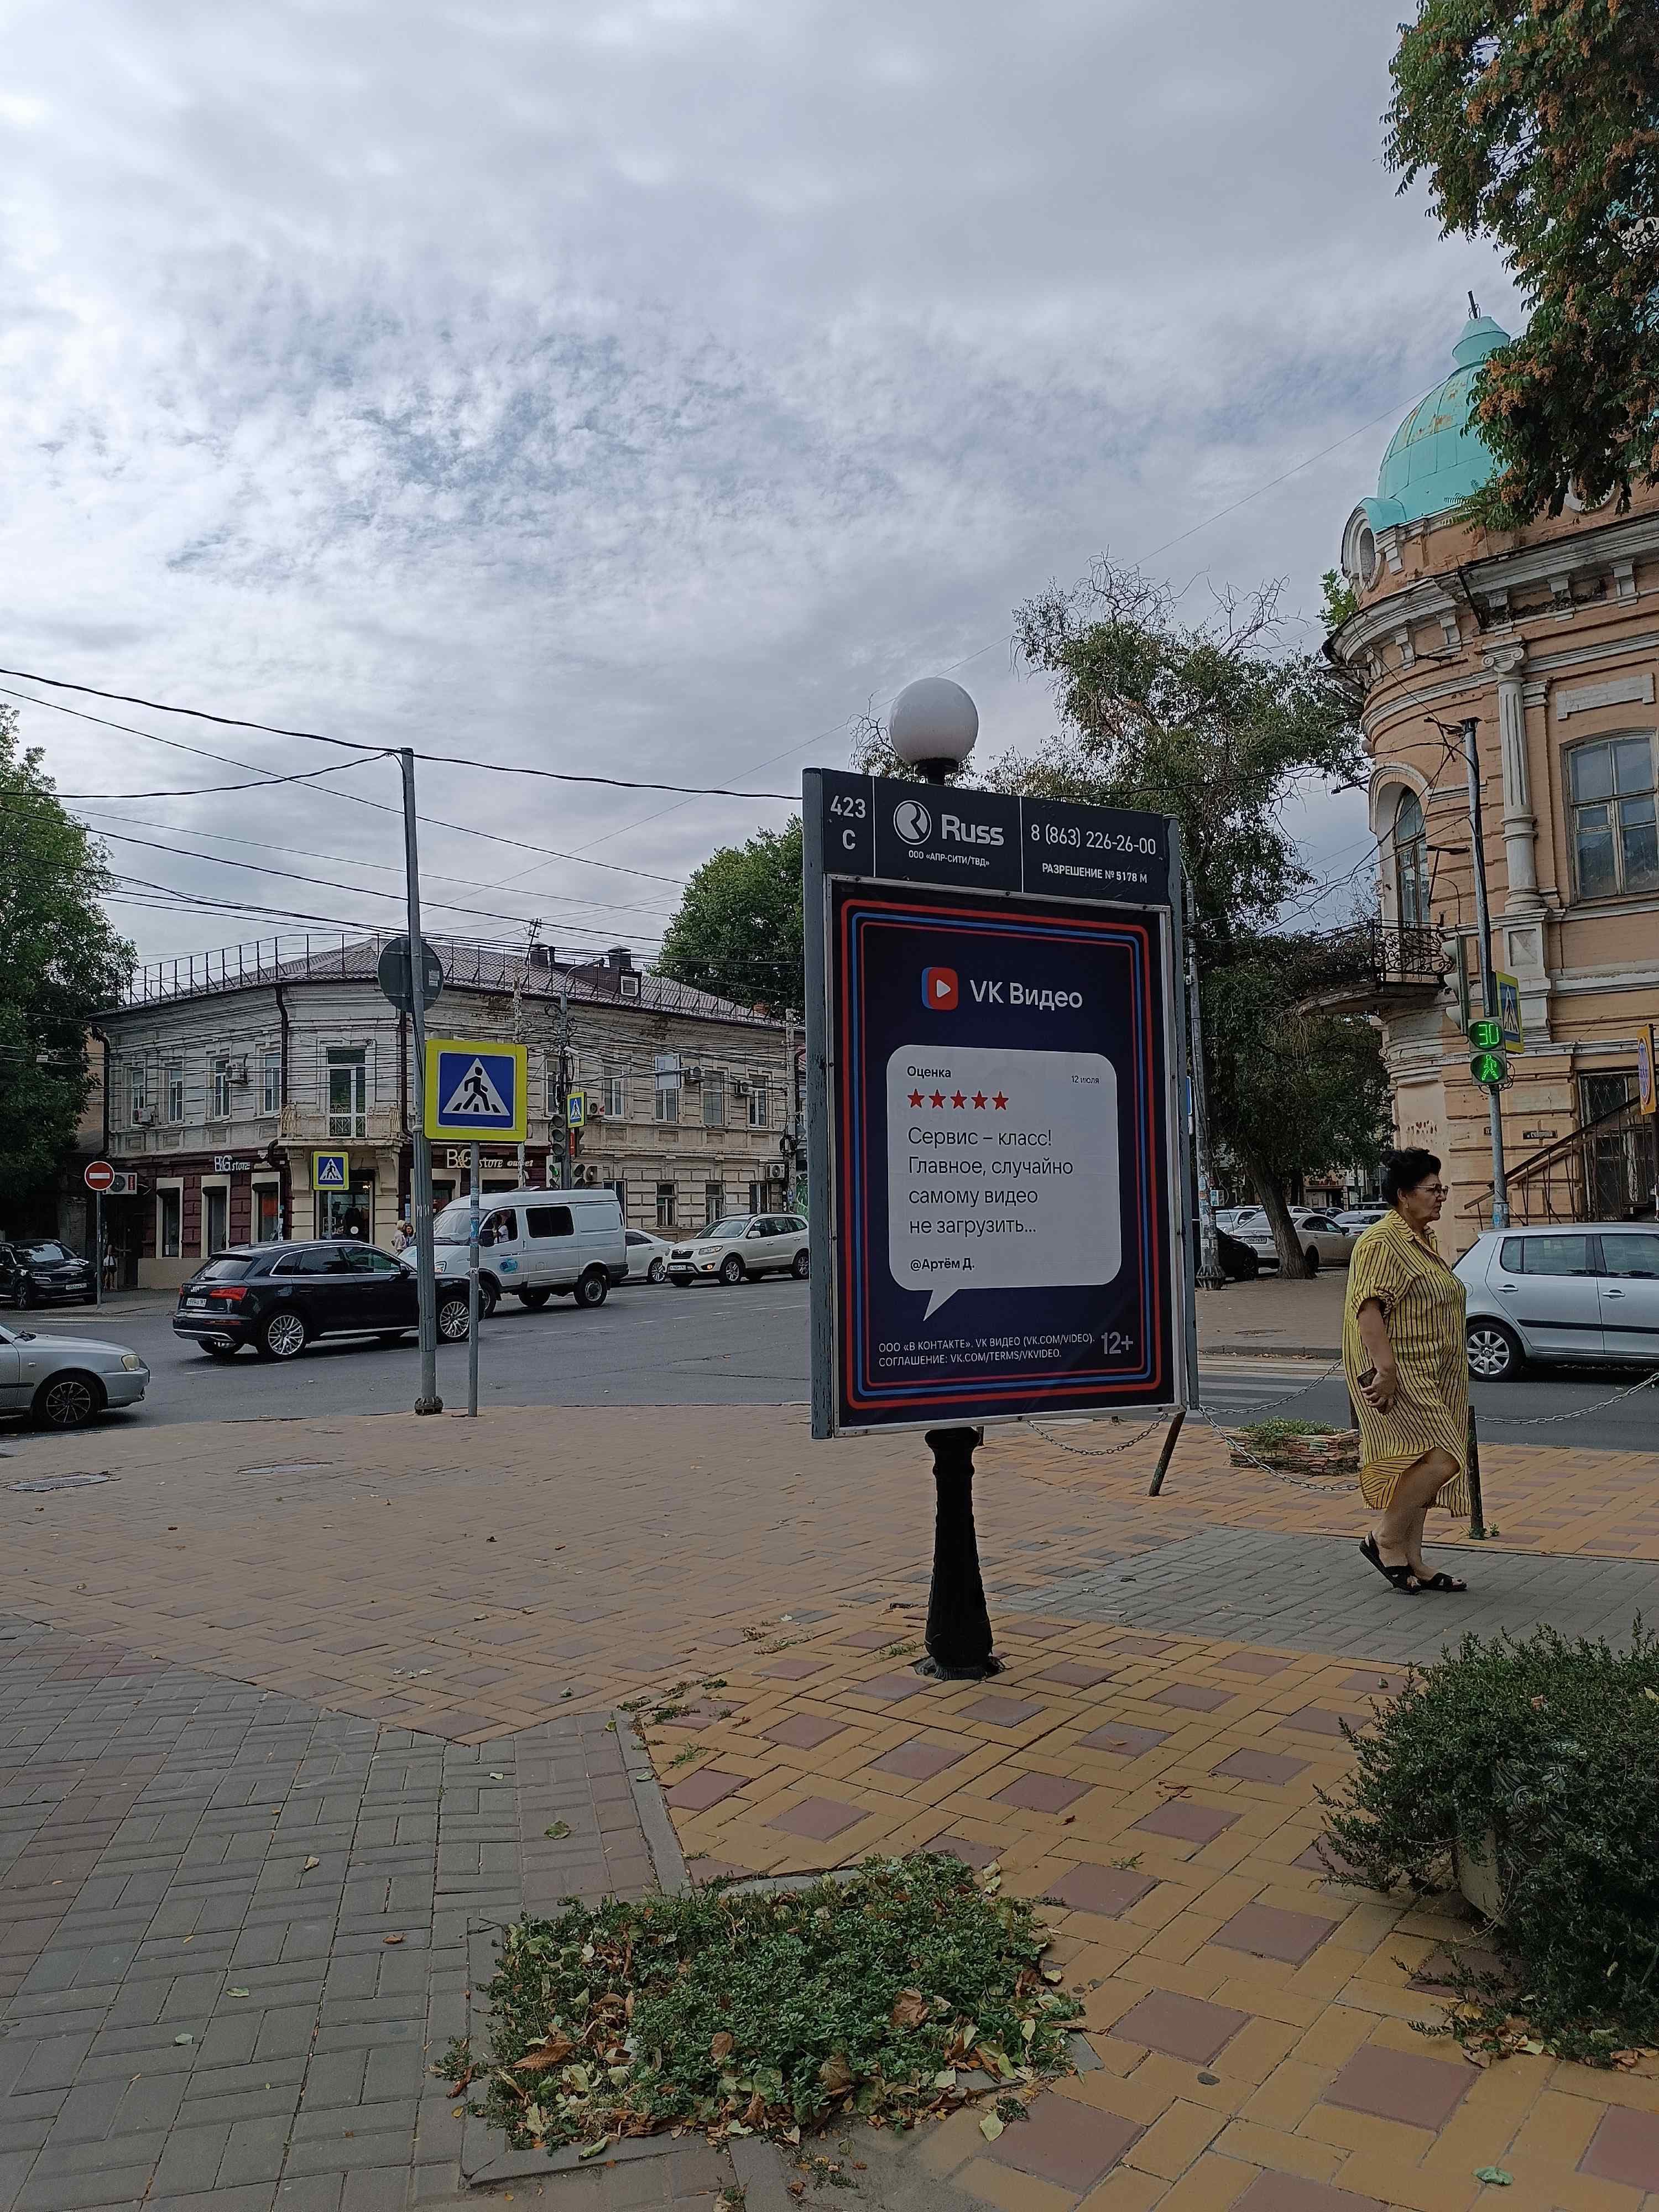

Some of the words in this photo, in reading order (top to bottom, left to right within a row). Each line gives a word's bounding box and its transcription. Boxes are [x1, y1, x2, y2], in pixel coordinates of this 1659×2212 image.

[830, 795, 866, 818] 423
[941, 813, 1004, 846] Russ
[1031, 824, 1040, 841] 8
[1046, 823, 1081, 848] (863)
[1086, 831, 1156, 854] 226-26-00
[909, 850, 924, 859] ООО
[926, 852, 990, 867] «АПР-СИТИ/ТВД»
[1042, 863, 1103, 879] РАЗРЕШЕНИЕ
[1116, 871, 1138, 882] 5178
[970, 980, 1004, 1003] VK
[1010, 982, 1083, 1011] Видео
[1478, 1024, 1499, 1045] 30
[907, 1066, 951, 1078] Оценка
[1071, 1075, 1078, 1084] 12
[908, 1126, 978, 1149] Сервис
[998, 1130, 1052, 1146] класс!
[479, 1157, 503, 1168] store
[909, 1156, 986, 1176] Главное,
[992, 1157, 1073, 1178] случайно
[909, 1190, 979, 1207] самому
[985, 1190, 1038, 1206] видео
[910, 1220, 932, 1234] не
[936, 1219, 1036, 1237] загрузить...
[910, 1259, 960, 1271] @Артём
[962, 1258, 975, 1270] Д.
[879, 1342, 900, 1353] ООО
[904, 1342, 915, 1351] «В
[918, 1339, 973, 1350] КОНТАКТЕ».
[975, 1338, 987, 1348] VK
[990, 1337, 1020, 1348] ВИДЕО
[1024, 1333, 1095, 1348] (VK.COM/VIDEO).
[1101, 1332, 1134, 1354] 12+
[879, 1354, 948, 1367] СОГЛАШЕНИЕ:
[951, 1348, 1062, 1364] VK.COM/TERMS/VKVIDEO.
